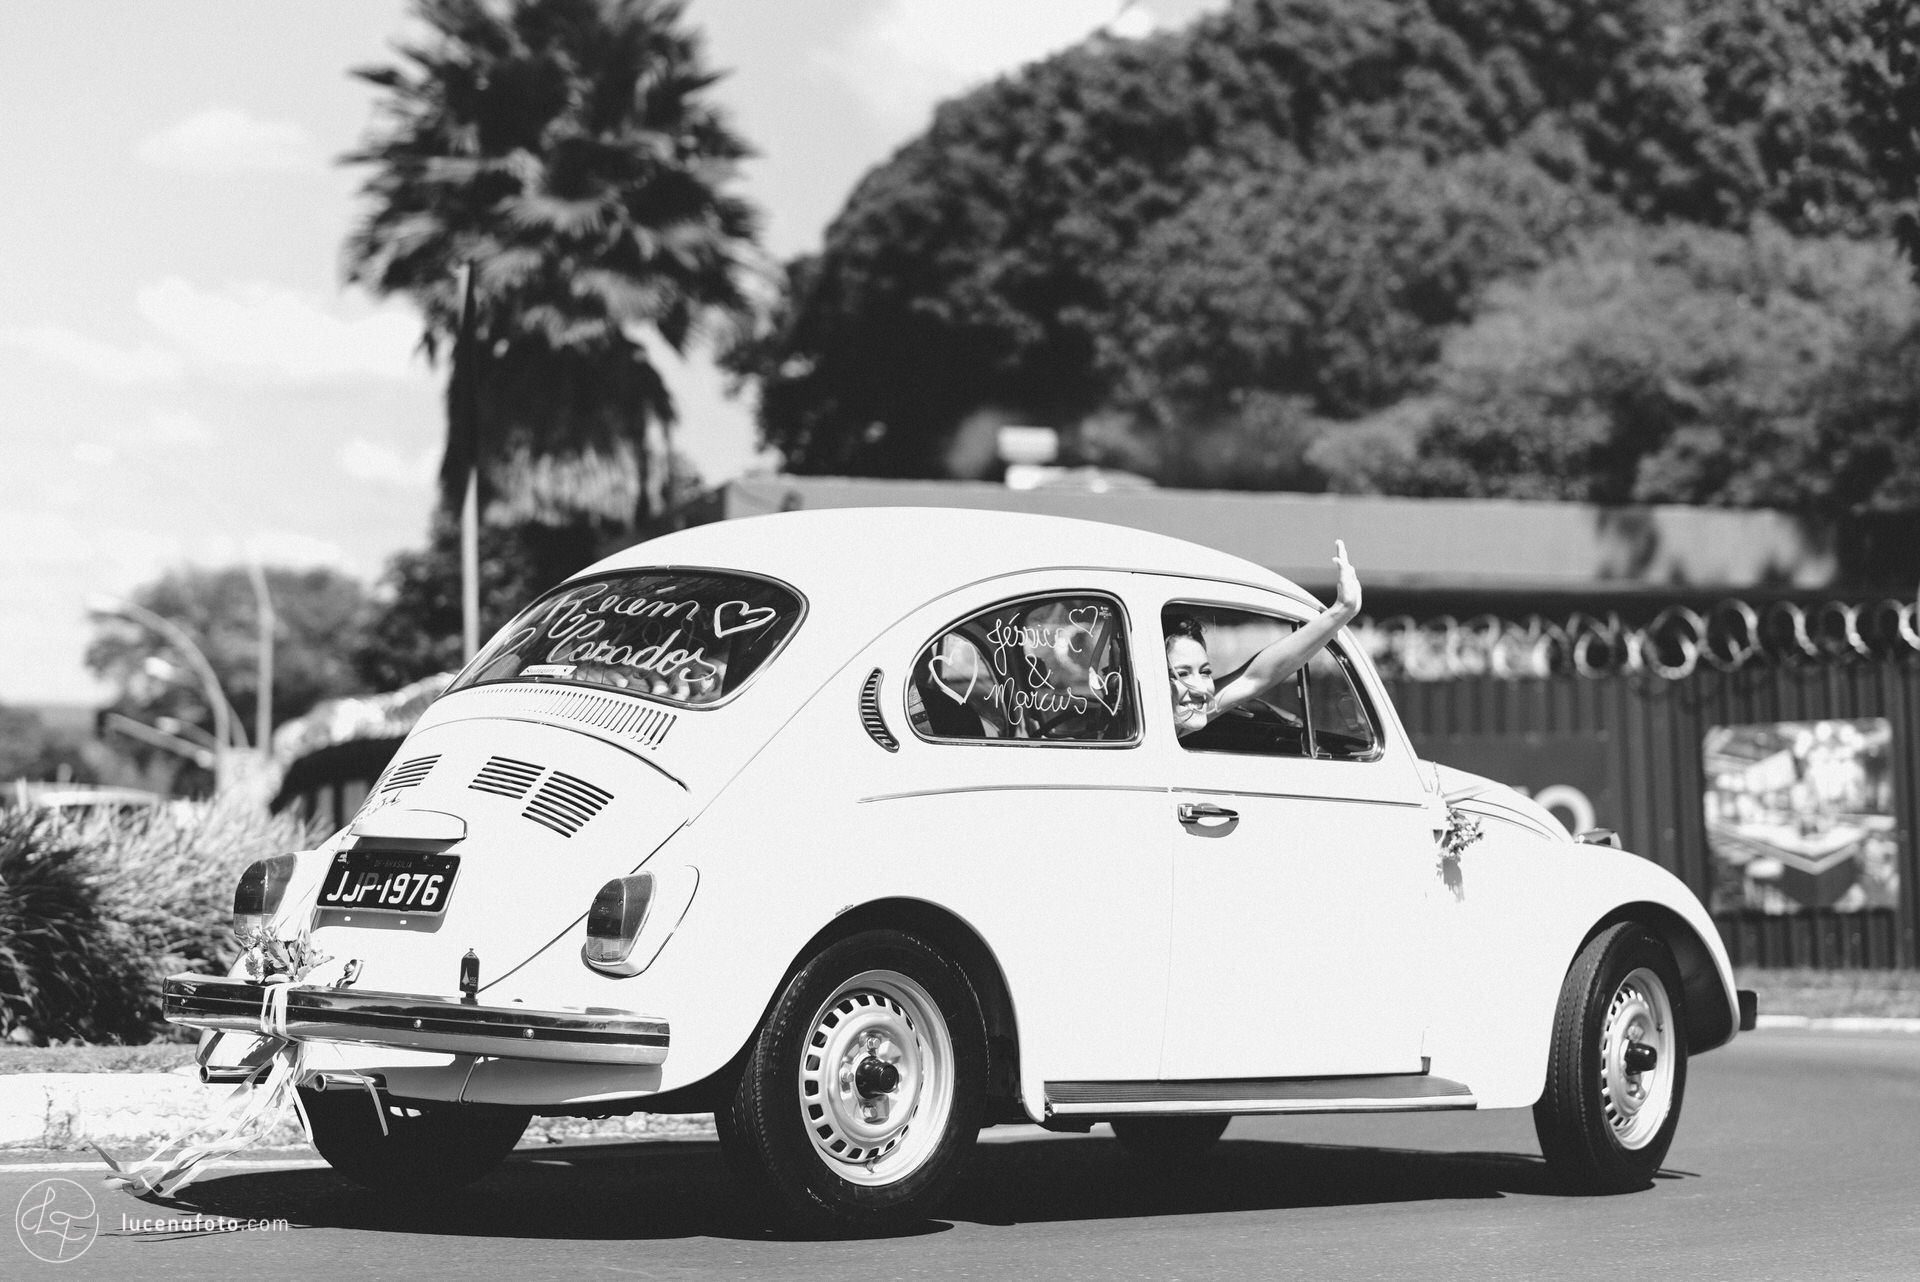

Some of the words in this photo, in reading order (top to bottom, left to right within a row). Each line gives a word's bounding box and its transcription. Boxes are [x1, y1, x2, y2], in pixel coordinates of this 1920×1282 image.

[546, 619, 717, 682] Casados
[986, 612, 1083, 676] Jéssica
[1025, 653, 1055, 690] &
[983, 677, 1088, 726] Marcus
